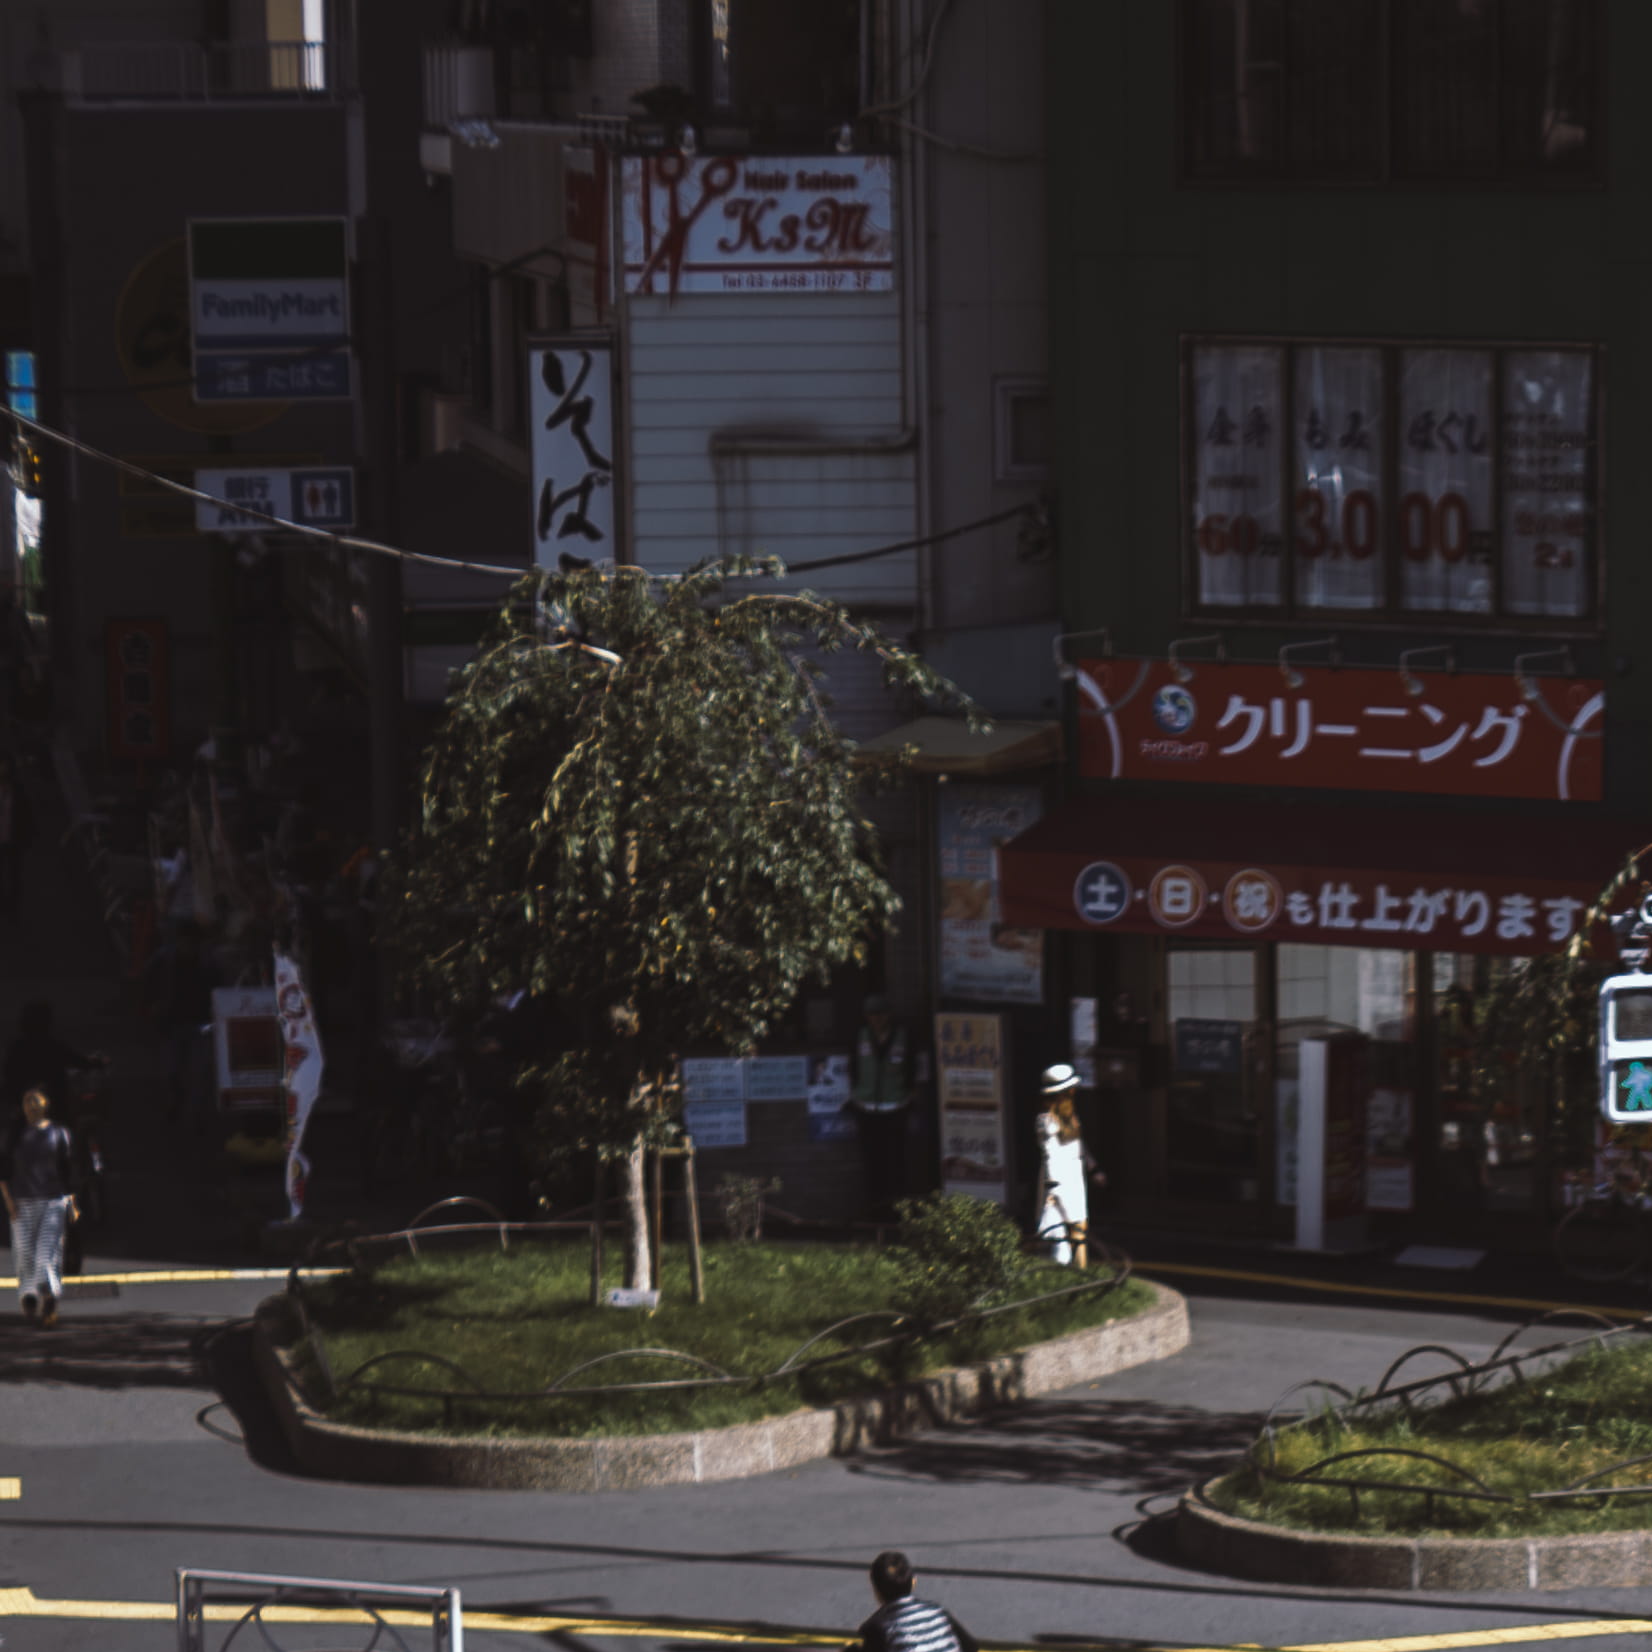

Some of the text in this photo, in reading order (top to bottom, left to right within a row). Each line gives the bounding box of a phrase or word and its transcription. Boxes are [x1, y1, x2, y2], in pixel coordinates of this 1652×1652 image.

[744, 169, 858, 191] Hair Salon
[201, 292, 341, 324] FamilyMart
[266, 363, 337, 389] たばこ
[537, 350, 613, 575] そば
[1216, 694, 1530, 768] クリーニング
